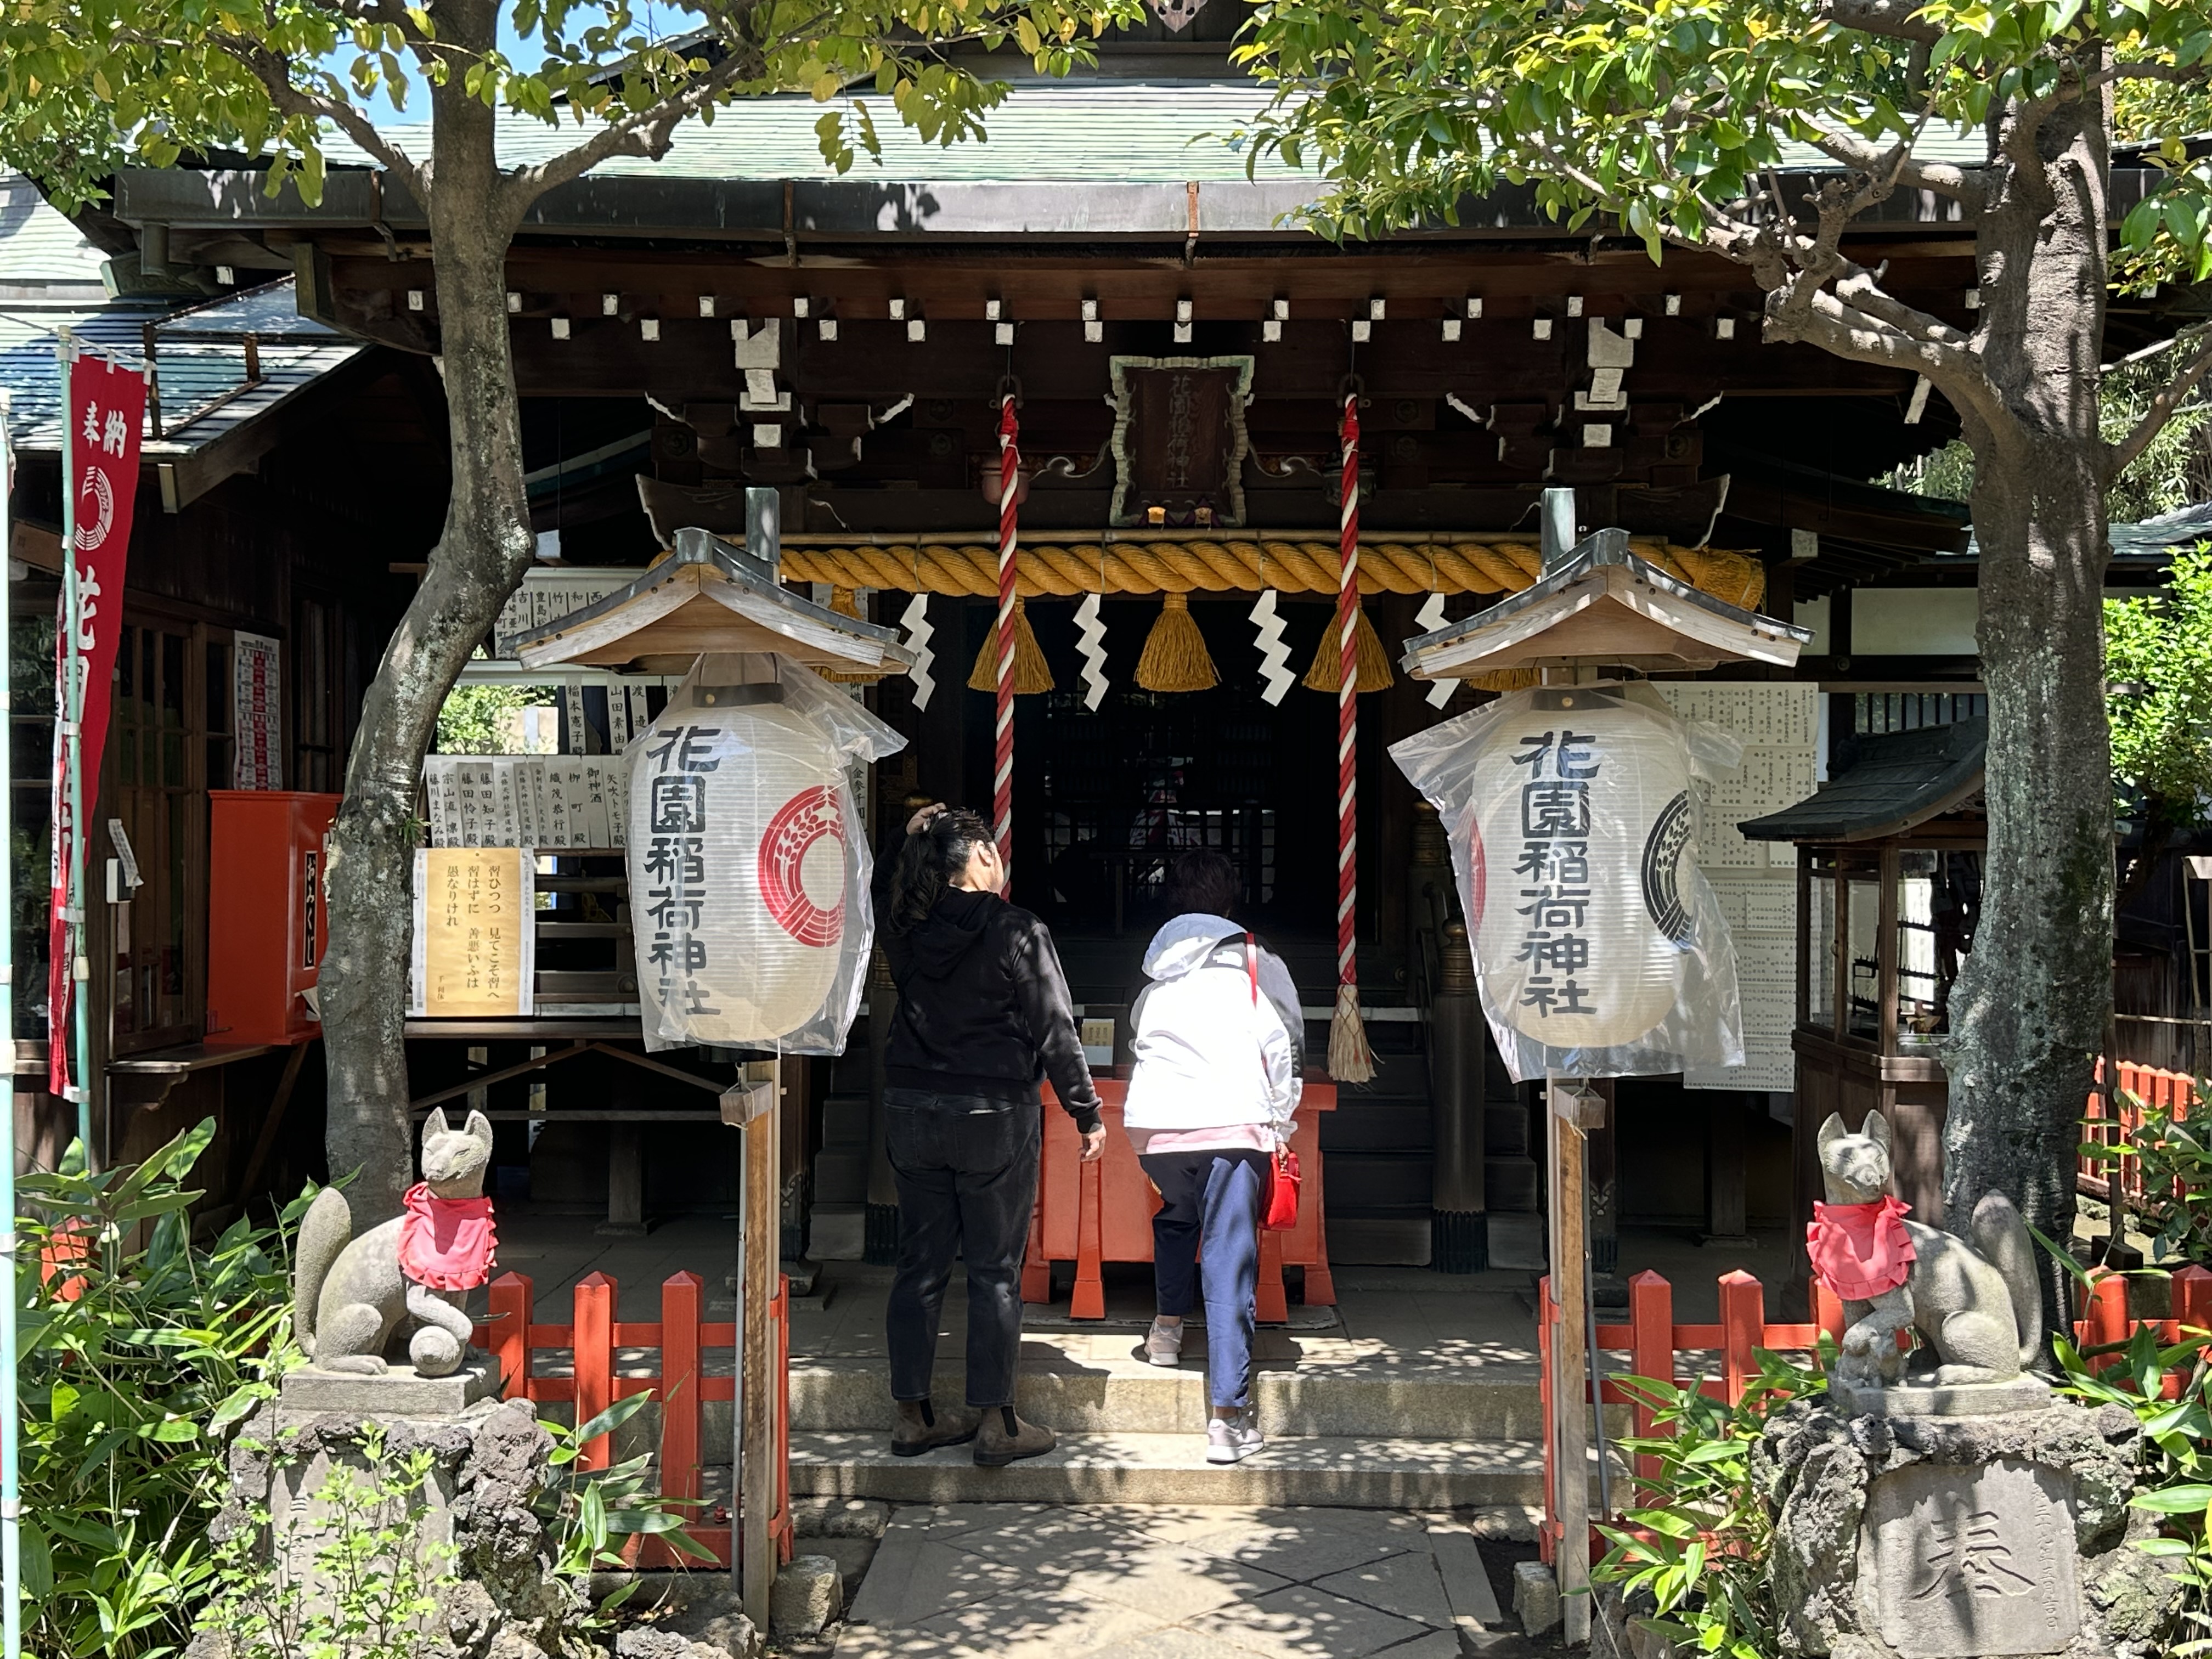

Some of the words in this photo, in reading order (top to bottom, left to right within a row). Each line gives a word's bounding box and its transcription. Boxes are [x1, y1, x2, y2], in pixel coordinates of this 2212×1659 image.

[82, 400, 128, 460] 奉納
[586, 767, 602, 803] 御神酒
[447, 865, 459, 927] 愚なりけれ
[467, 865, 480, 914] 習はずに
[488, 865, 501, 913] 習ひつつ
[643, 725, 721, 1016] 花園稲荷神社
[1509, 730, 1601, 1019] 花園稲荷神社
[306, 856, 316, 964] おみくじ
[467, 927, 480, 988] 善悪いふは
[487, 928, 501, 998] 見てこそ習へ
